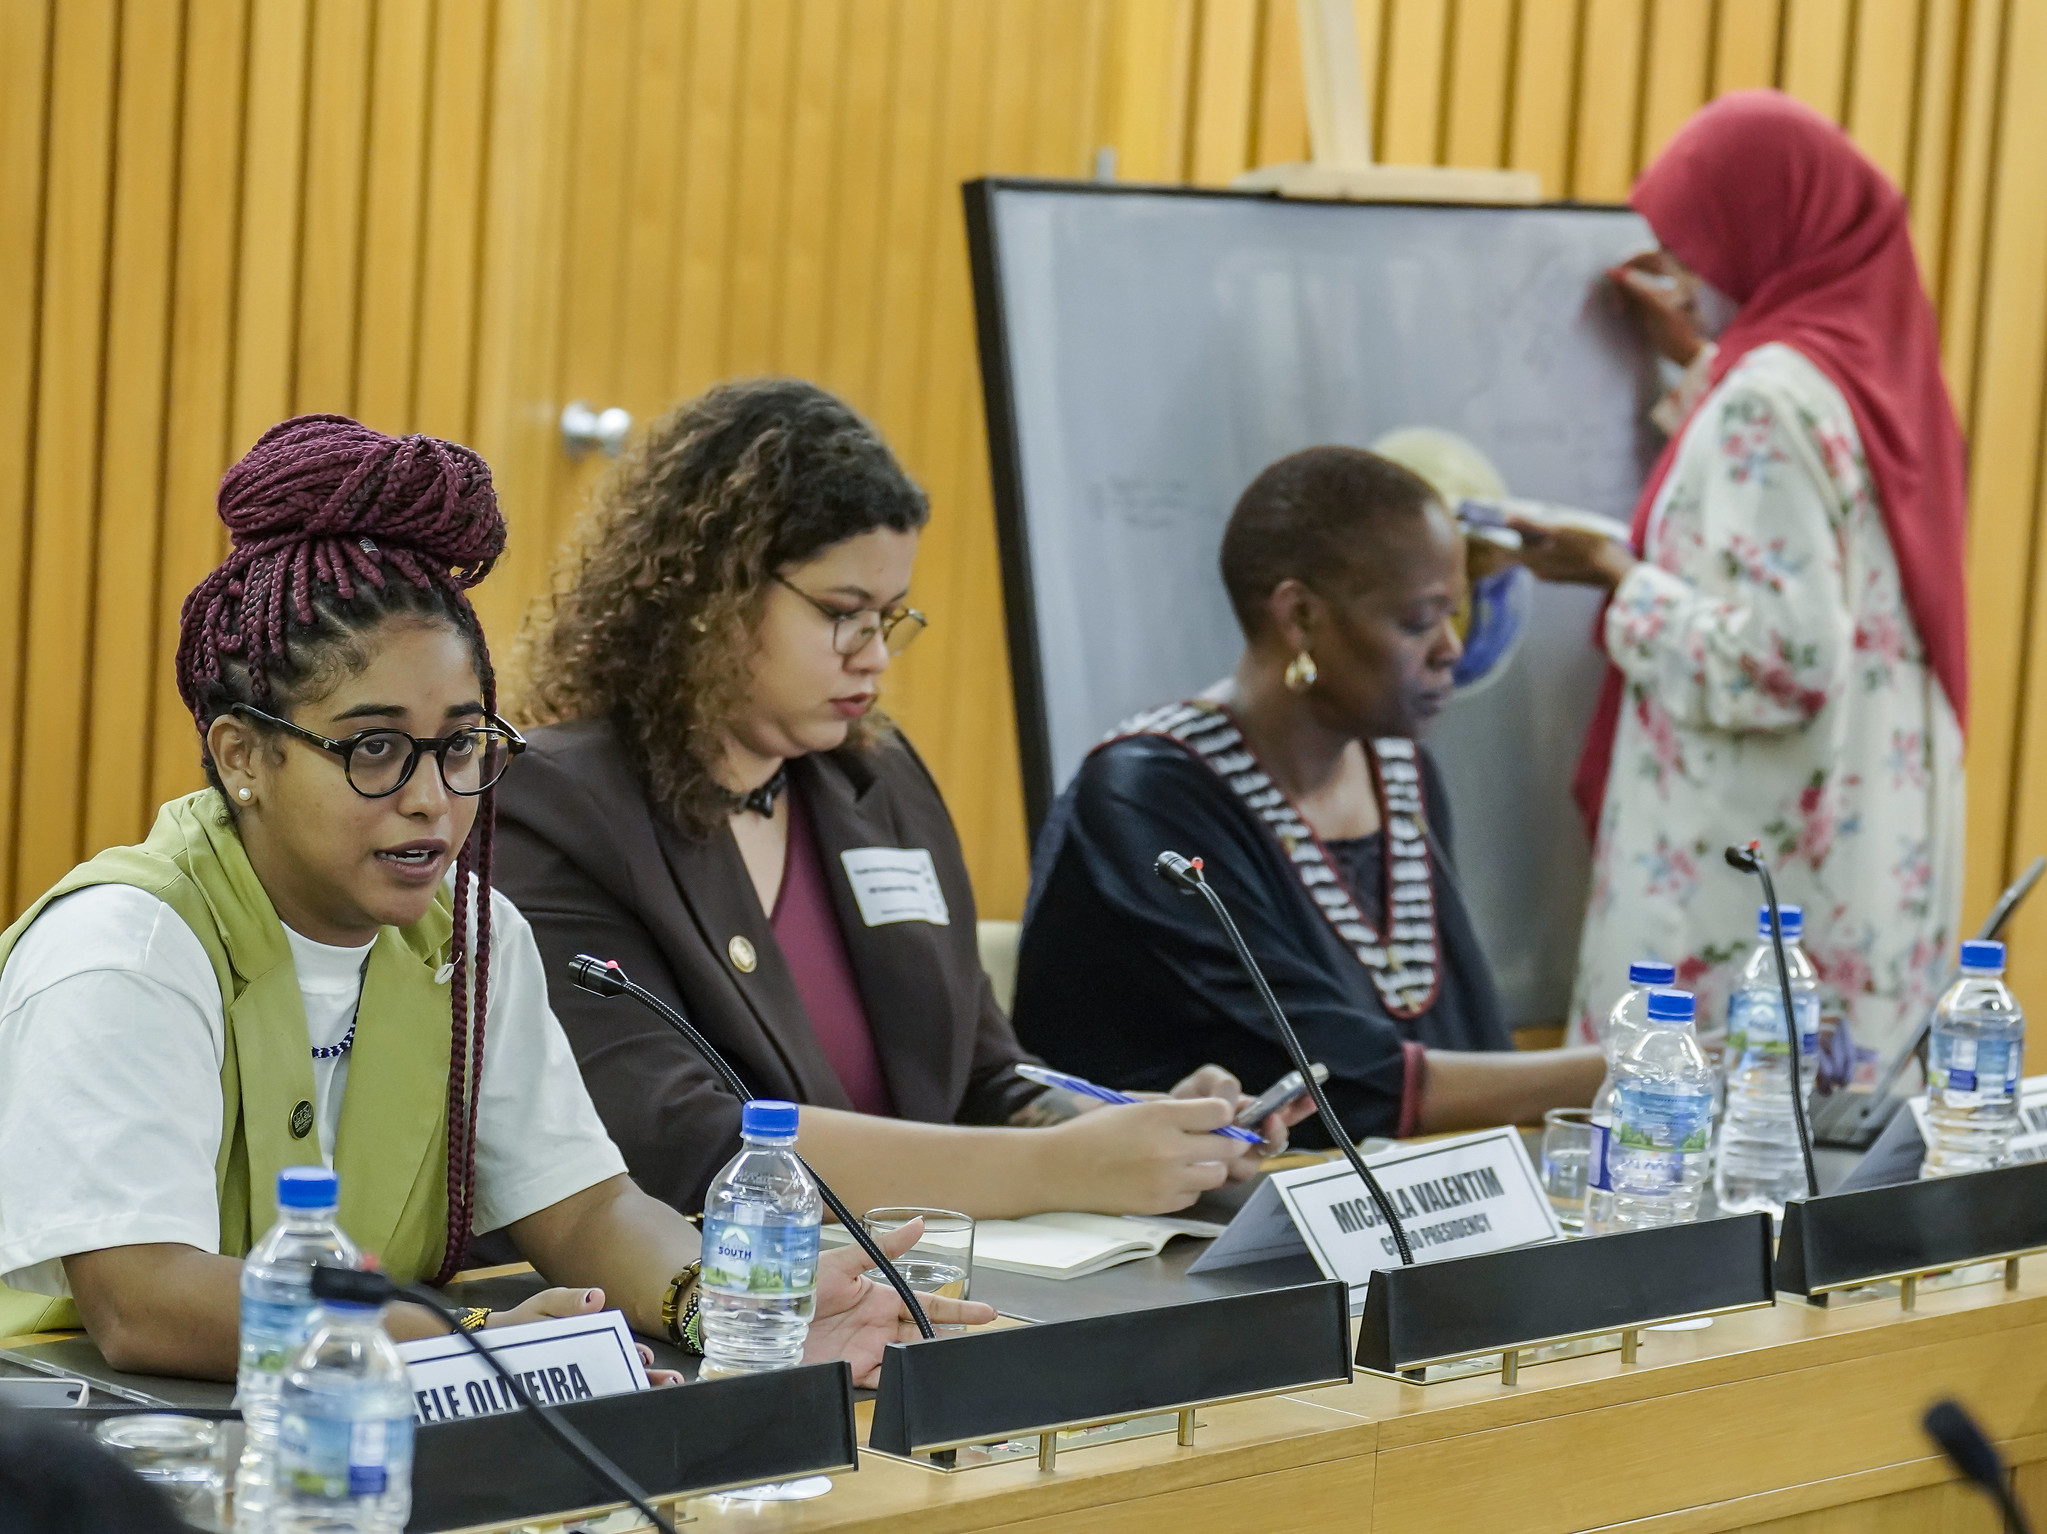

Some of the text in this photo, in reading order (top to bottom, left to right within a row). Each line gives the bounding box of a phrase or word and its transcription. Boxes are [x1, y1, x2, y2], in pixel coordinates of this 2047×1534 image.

[1329, 1166, 1505, 1234] MICALA VALENTIM
[1420, 1213, 1492, 1246] PRESIDENCY
[718, 1246, 751, 1260] SOUTH
[413, 1385, 465, 1424] ELE
